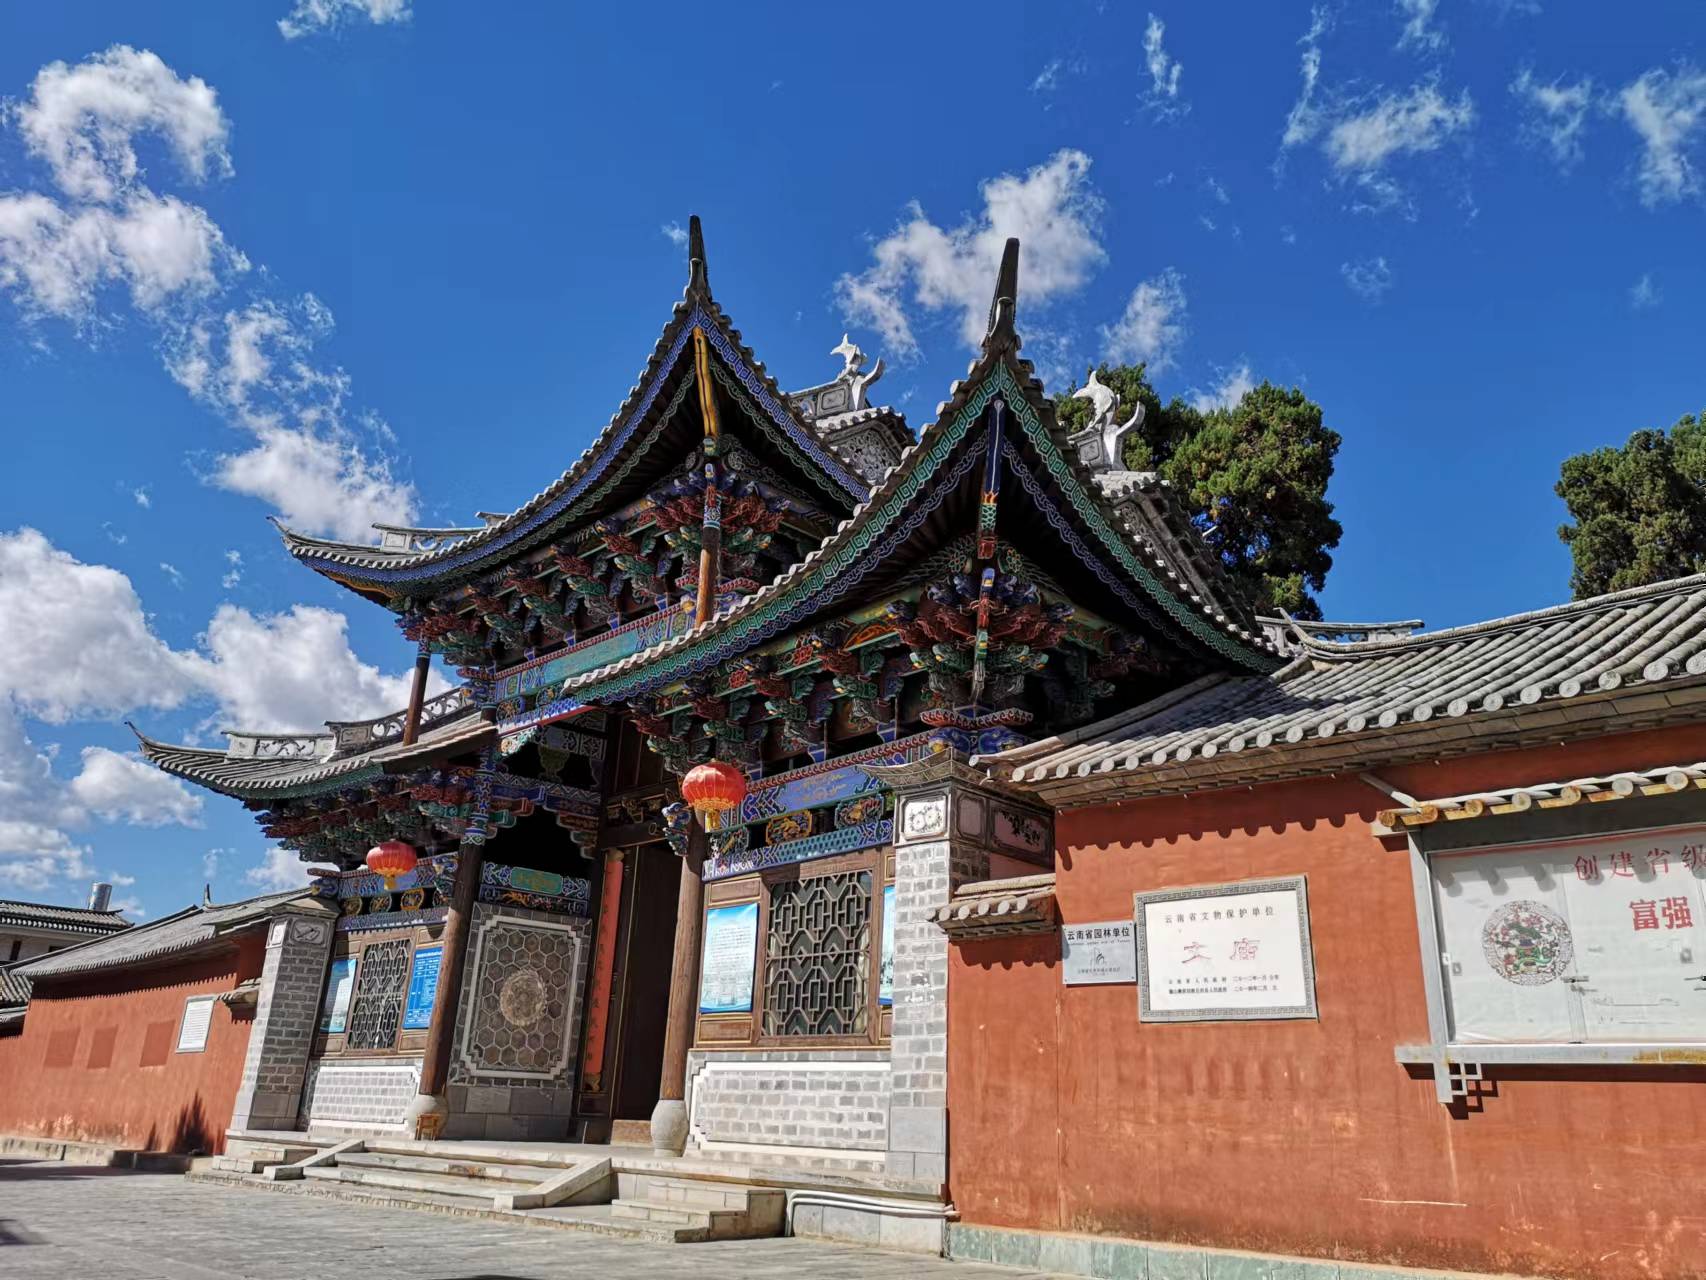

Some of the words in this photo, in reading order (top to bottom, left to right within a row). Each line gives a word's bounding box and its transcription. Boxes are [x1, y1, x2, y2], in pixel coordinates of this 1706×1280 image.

[1165, 906, 1274, 923] 云南省文物保护单位
[1629, 896, 1693, 930] 富强
[1067, 926, 1130, 940] 云南省园林单位
